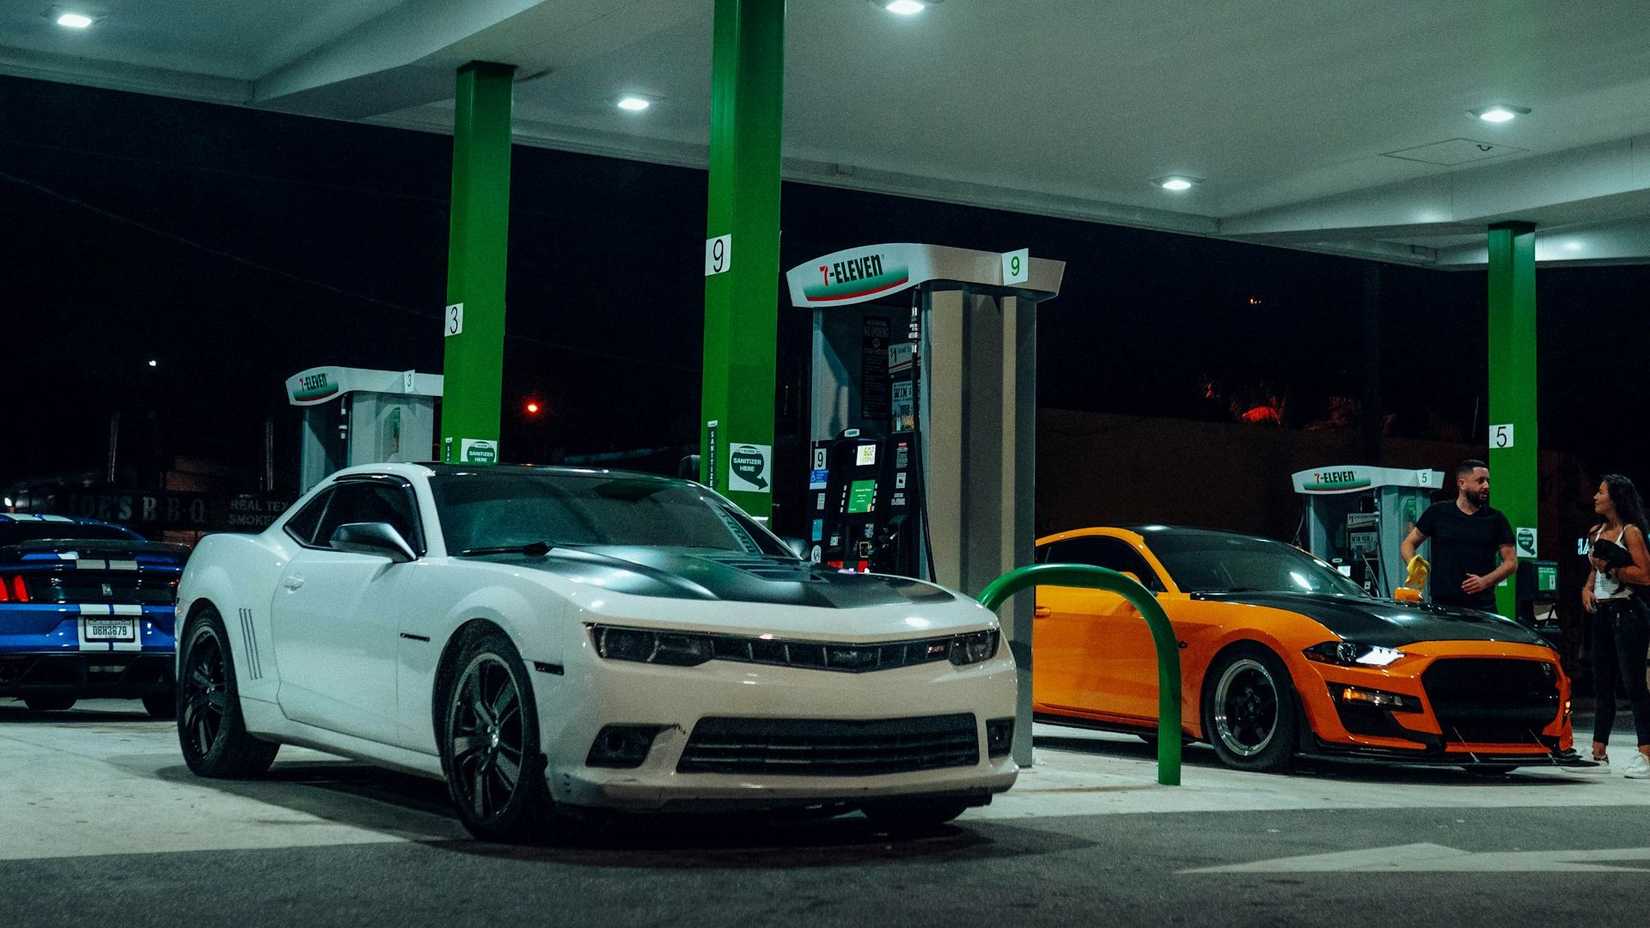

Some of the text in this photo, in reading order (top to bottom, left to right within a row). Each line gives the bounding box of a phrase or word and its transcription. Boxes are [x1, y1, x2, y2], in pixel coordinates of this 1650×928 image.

[713, 239, 724, 273] 9
[1011, 255, 1020, 277] 9
[450, 306, 459, 334] 3
[407, 373, 412, 388] 3
[1496, 426, 1508, 448] 5
[732, 457, 762, 466] SANITIZER
[739, 464, 756, 472] HERE
[816, 451, 824, 468] 9
[1421, 472, 1429, 484] 5
